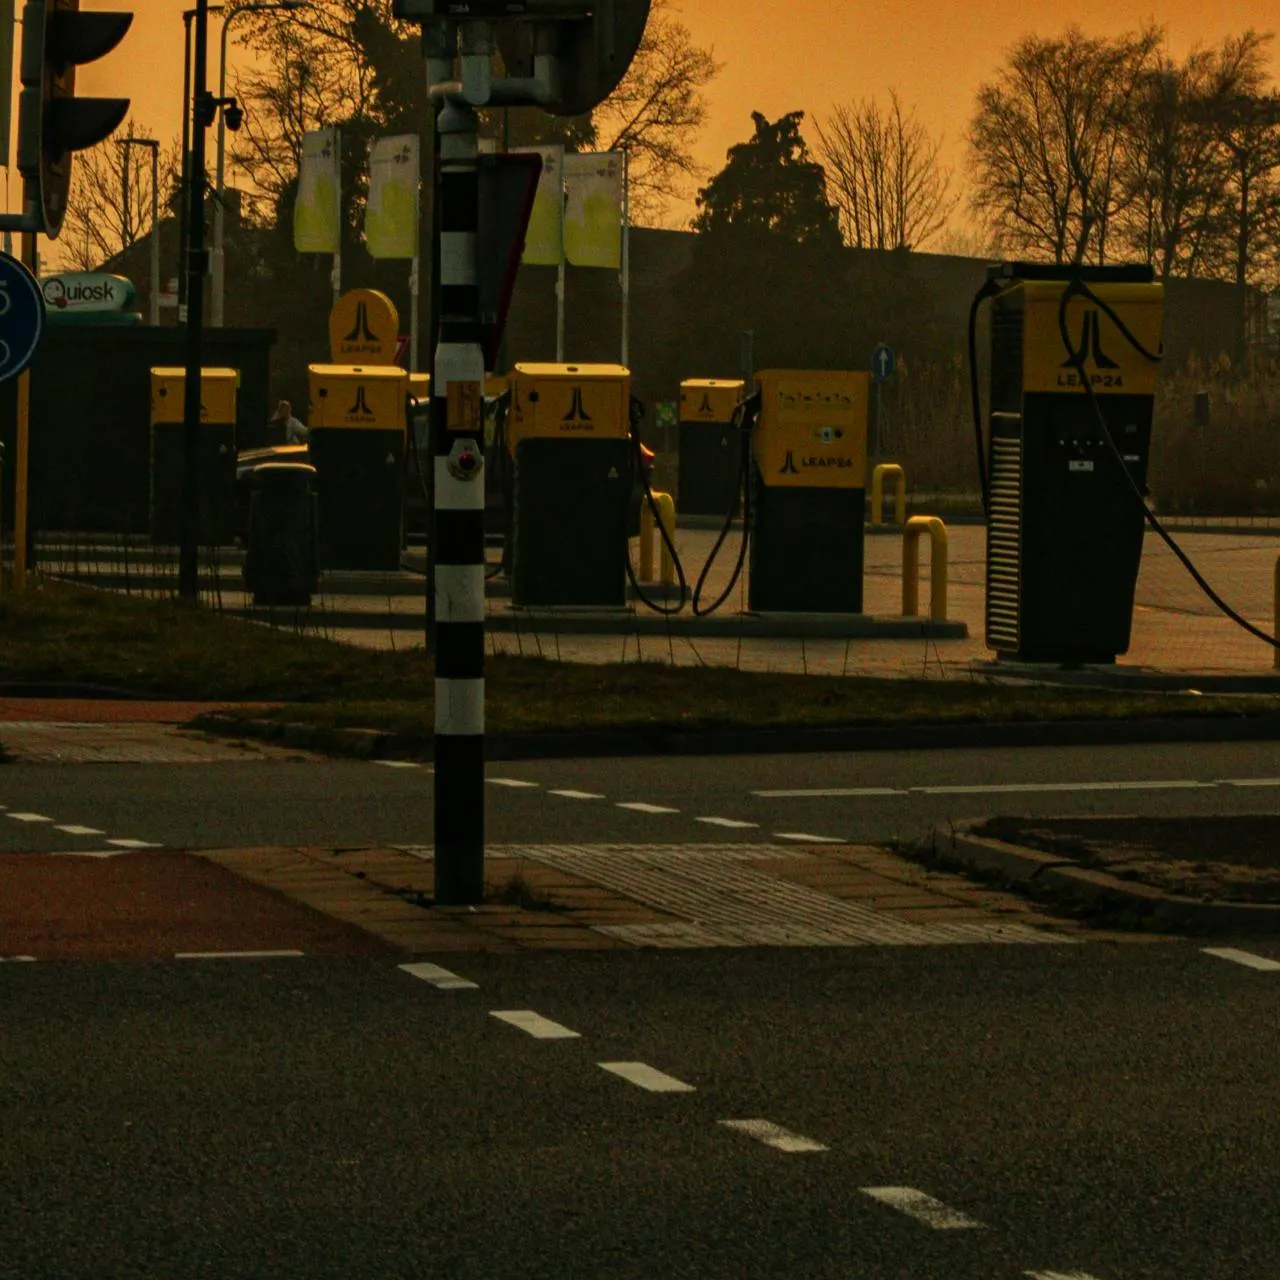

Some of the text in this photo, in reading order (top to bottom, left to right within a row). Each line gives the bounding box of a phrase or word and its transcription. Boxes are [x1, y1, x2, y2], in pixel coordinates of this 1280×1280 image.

[42, 278, 114, 308] Quiosk
[1057, 374, 1122, 387] LEP24
[802, 457, 852, 469] LEAP24
